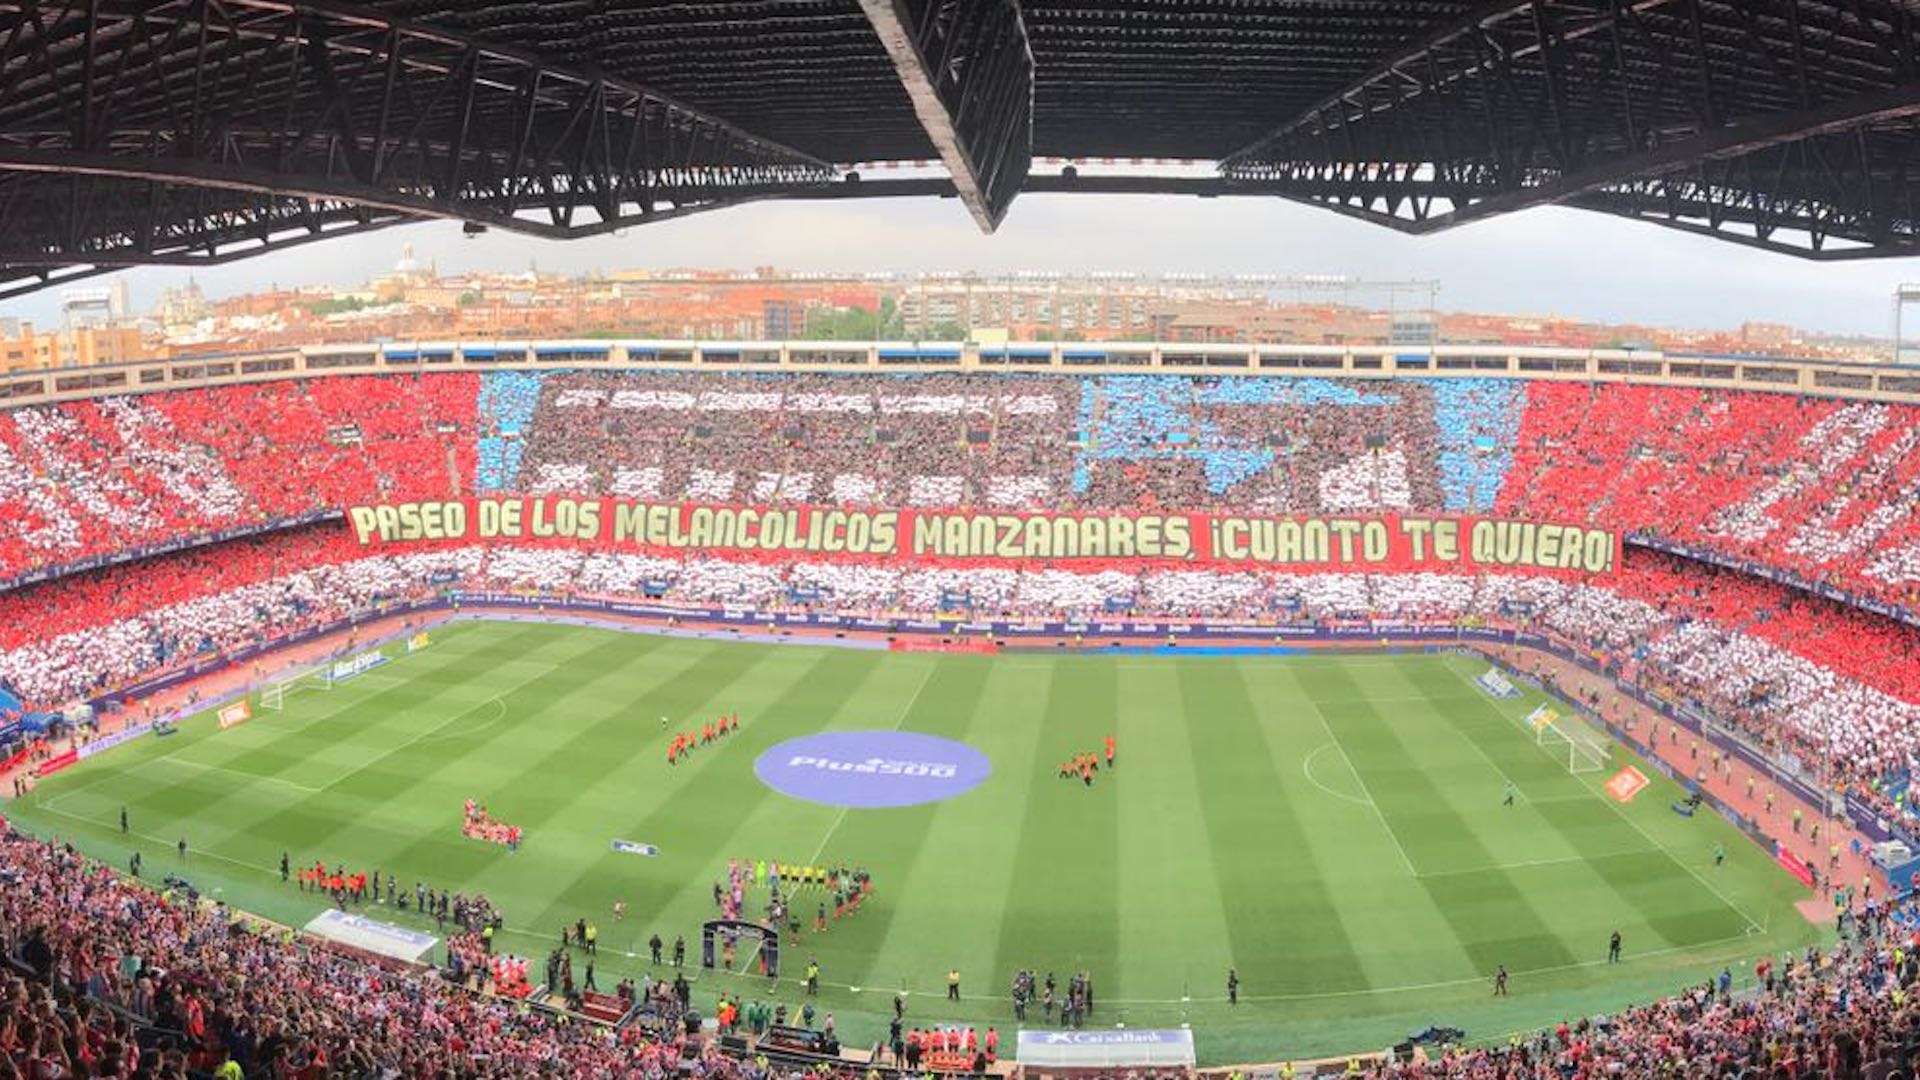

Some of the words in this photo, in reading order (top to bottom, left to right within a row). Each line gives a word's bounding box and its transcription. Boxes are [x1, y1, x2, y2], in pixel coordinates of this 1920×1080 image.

[350, 500, 467, 545] PASEO
[478, 499, 523, 537] DE
[531, 499, 601, 540] LOS
[1402, 519, 1459, 561] TE
[1471, 521, 1615, 573] QUIERO!
